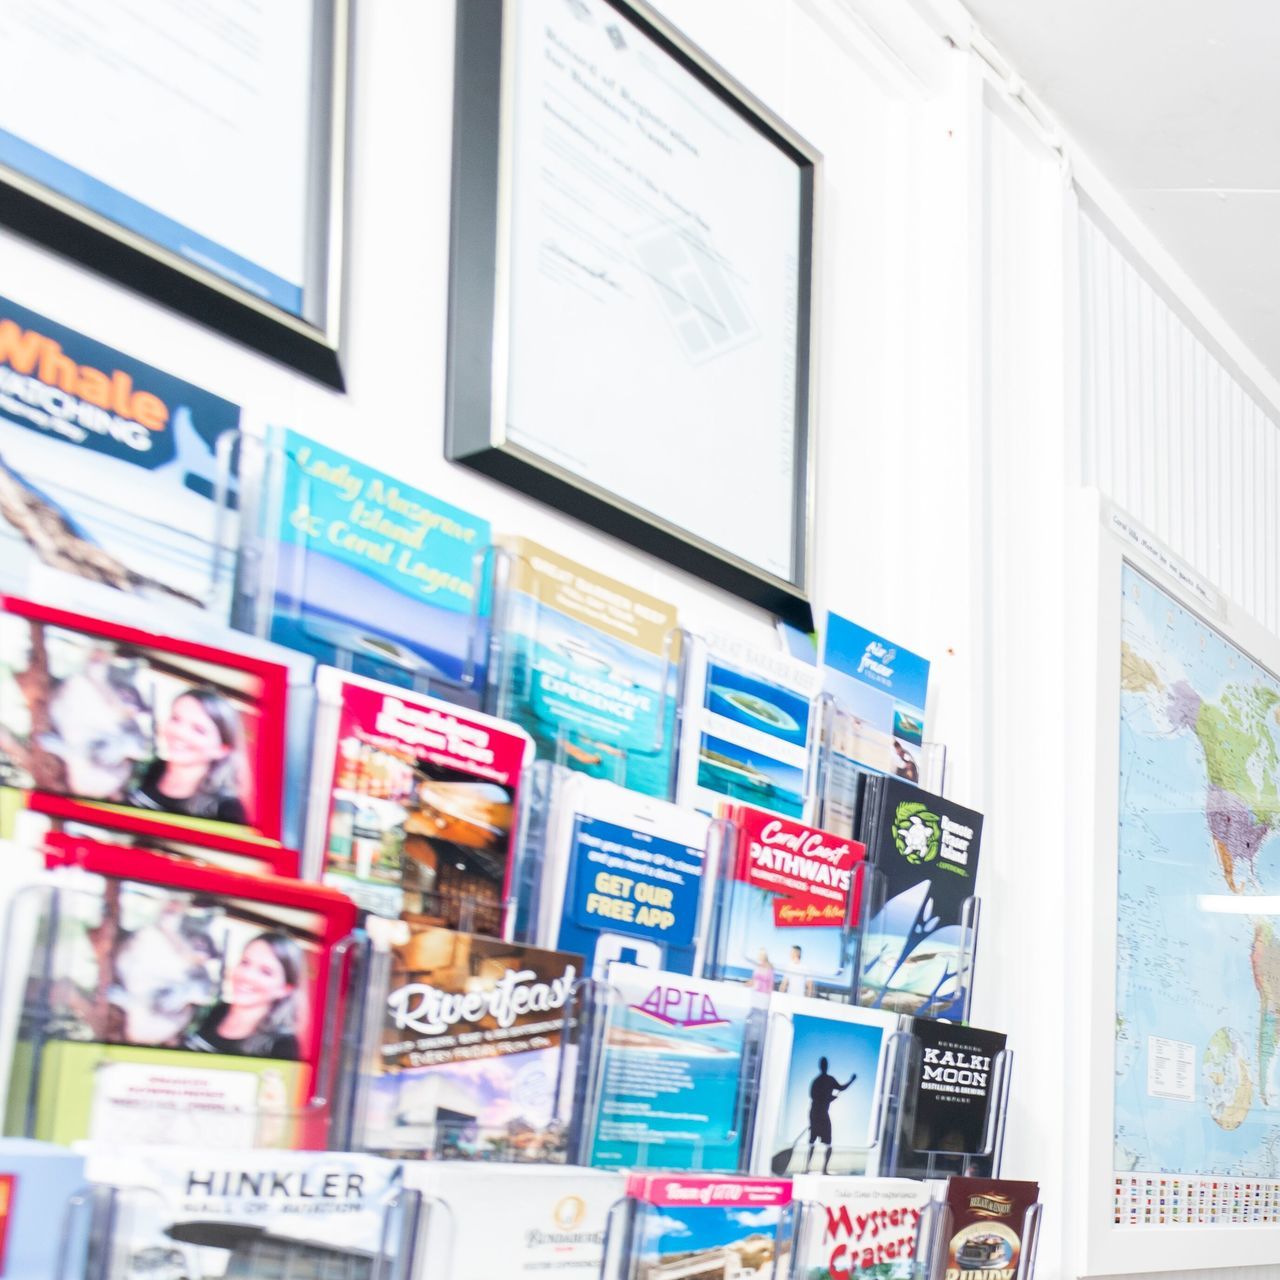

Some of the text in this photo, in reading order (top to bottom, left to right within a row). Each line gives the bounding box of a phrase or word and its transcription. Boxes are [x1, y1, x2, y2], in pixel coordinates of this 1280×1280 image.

[0, 318, 170, 432] Whale
[295, 446, 364, 503] Lady
[327, 519, 396, 565] Coral
[350, 500, 430, 551] Island
[760, 819, 851, 866] Coral Coast
[750, 842, 852, 892] PATHWAYS
[585, 892, 676, 930] FREE APP
[594, 871, 675, 909] GET OUR
[387, 963, 578, 1035] Riverfeast
[640, 984, 724, 1024] APTA
[921, 1064, 988, 1088] MOON
[922, 1047, 992, 1072] KALKI
[184, 1169, 366, 1199] HINKLER
[664, 1182, 700, 1200] Town
[823, 1203, 922, 1246] Mystery
